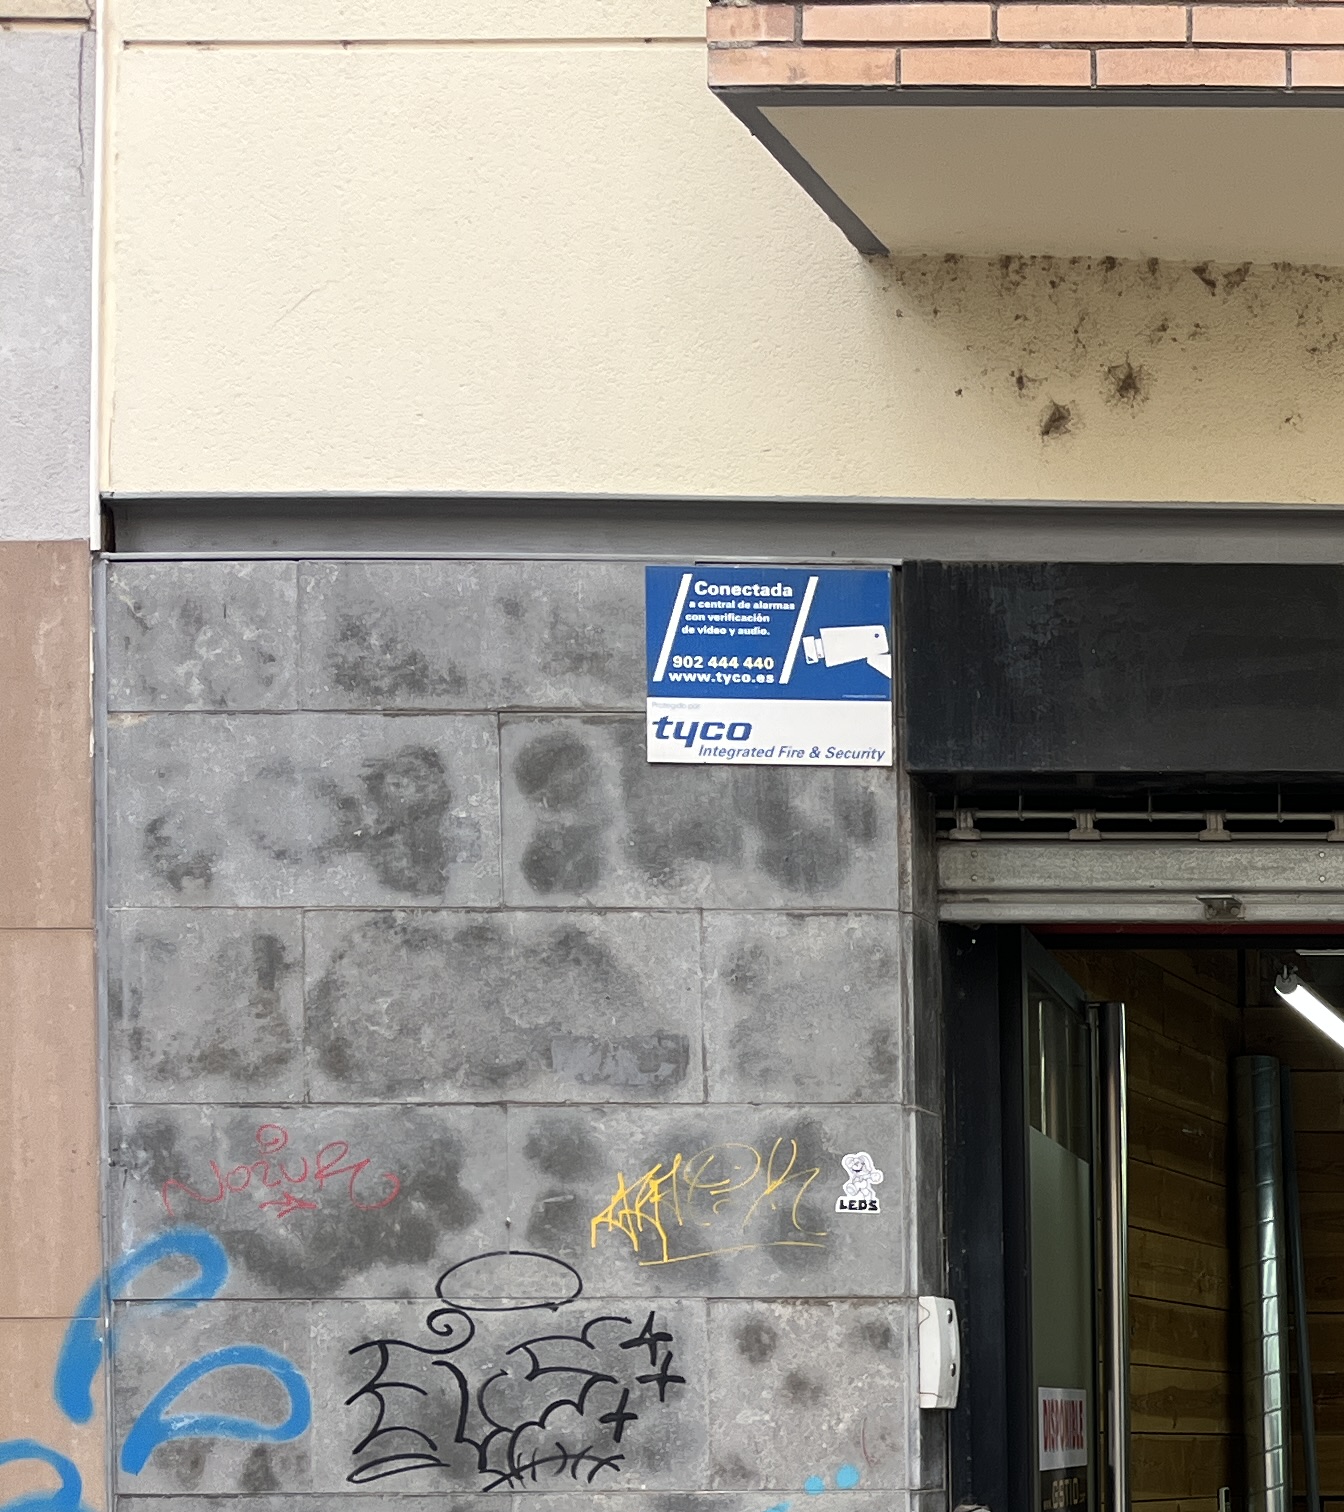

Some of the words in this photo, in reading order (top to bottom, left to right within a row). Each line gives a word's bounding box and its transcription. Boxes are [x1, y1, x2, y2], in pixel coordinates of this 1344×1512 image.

[694, 580, 793, 597] Conectada
[689, 601, 696, 609] a
[698, 600, 735, 609] central
[737, 600, 751, 609] de
[753, 601, 795, 610] alarmas
[685, 613, 706, 621] con
[708, 613, 770, 622] verificación
[681, 625, 696, 634] de
[729, 628, 735, 636] y
[737, 627, 770, 635] audio.
[672, 655, 704, 668] 902
[707, 656, 740, 669] 444
[743, 656, 774, 670] 440
[668, 671, 775, 685] www.tyco.es
[652, 715, 753, 748] tyco
[699, 744, 774, 760] Integrated
[778, 747, 804, 759] Fire
[809, 747, 820, 759] &
[825, 747, 886, 762] Security
[839, 1199, 878, 1211] LEDS
